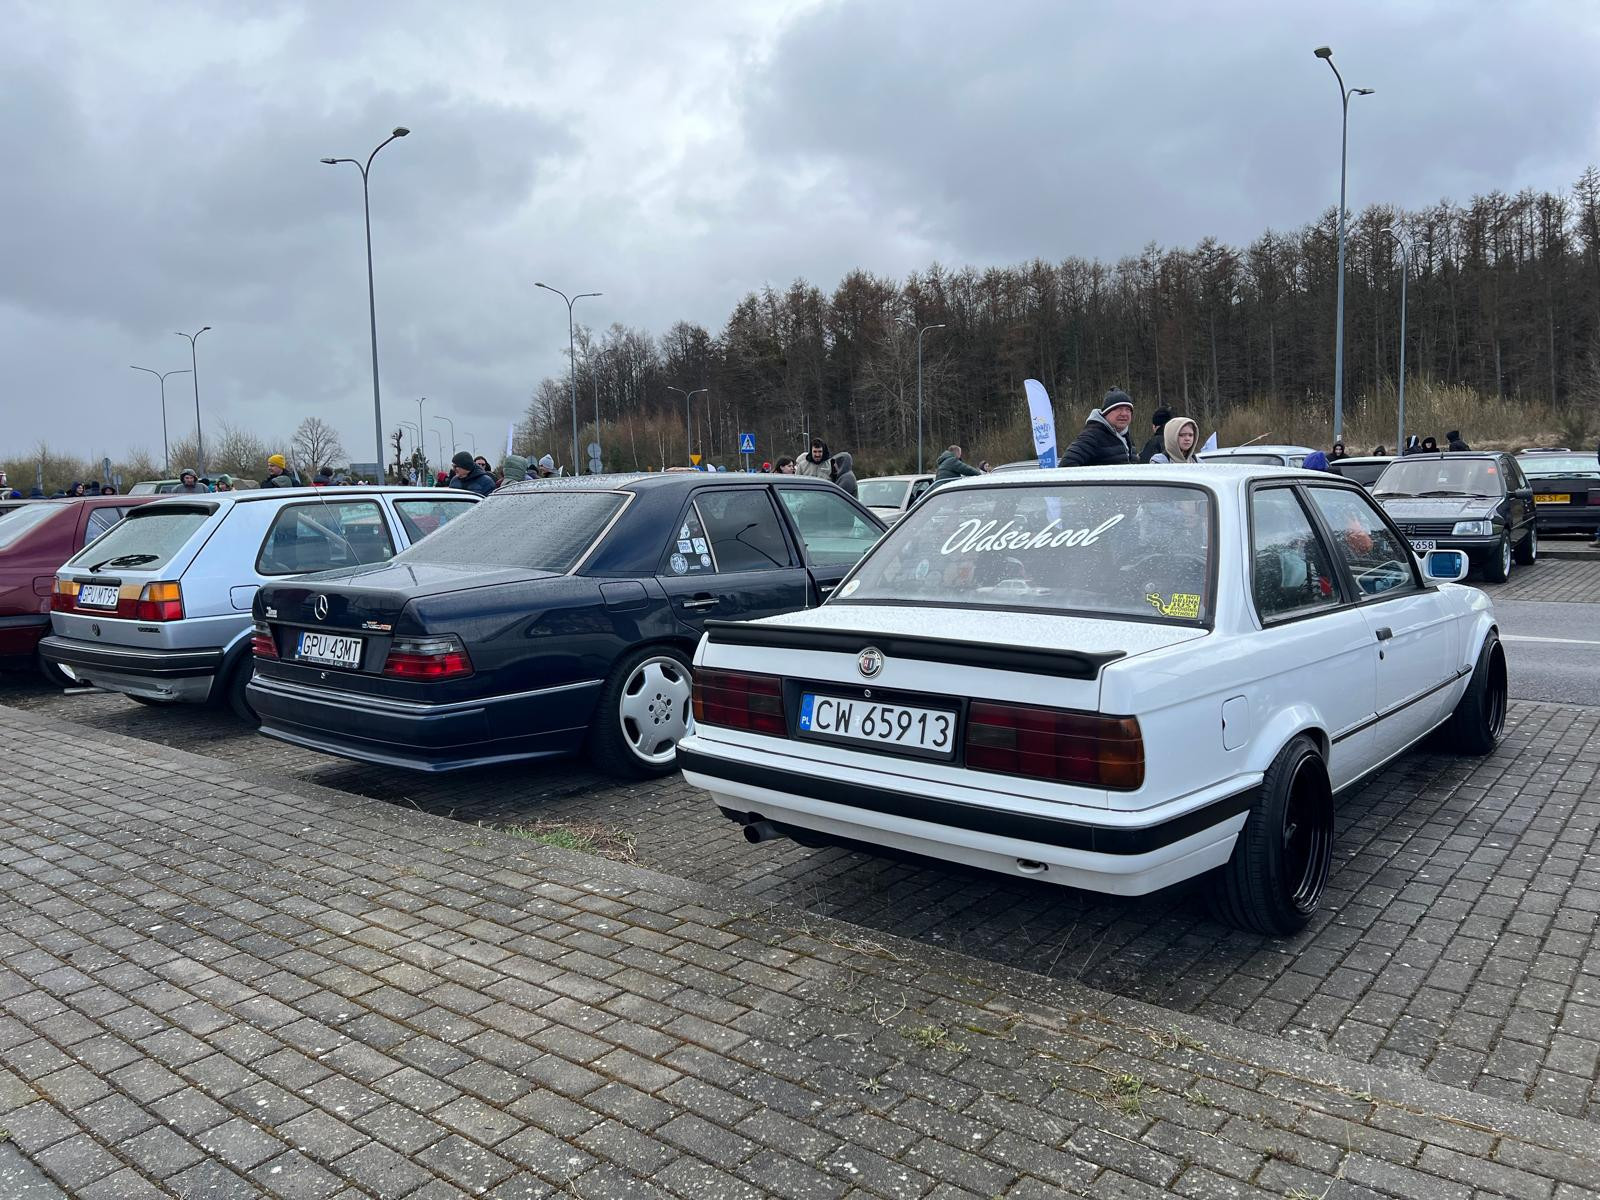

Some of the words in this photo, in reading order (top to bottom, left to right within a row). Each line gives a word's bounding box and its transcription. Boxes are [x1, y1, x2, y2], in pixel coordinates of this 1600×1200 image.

[941, 513, 1125, 555] Oldschool
[82, 586, 97, 603] GPU
[97, 588, 118, 605] MT95
[303, 634, 328, 657] GPU
[330, 638, 361, 662] 43MT
[801, 716, 810, 725] PL
[816, 700, 853, 733] CW
[861, 706, 950, 747] 65913
